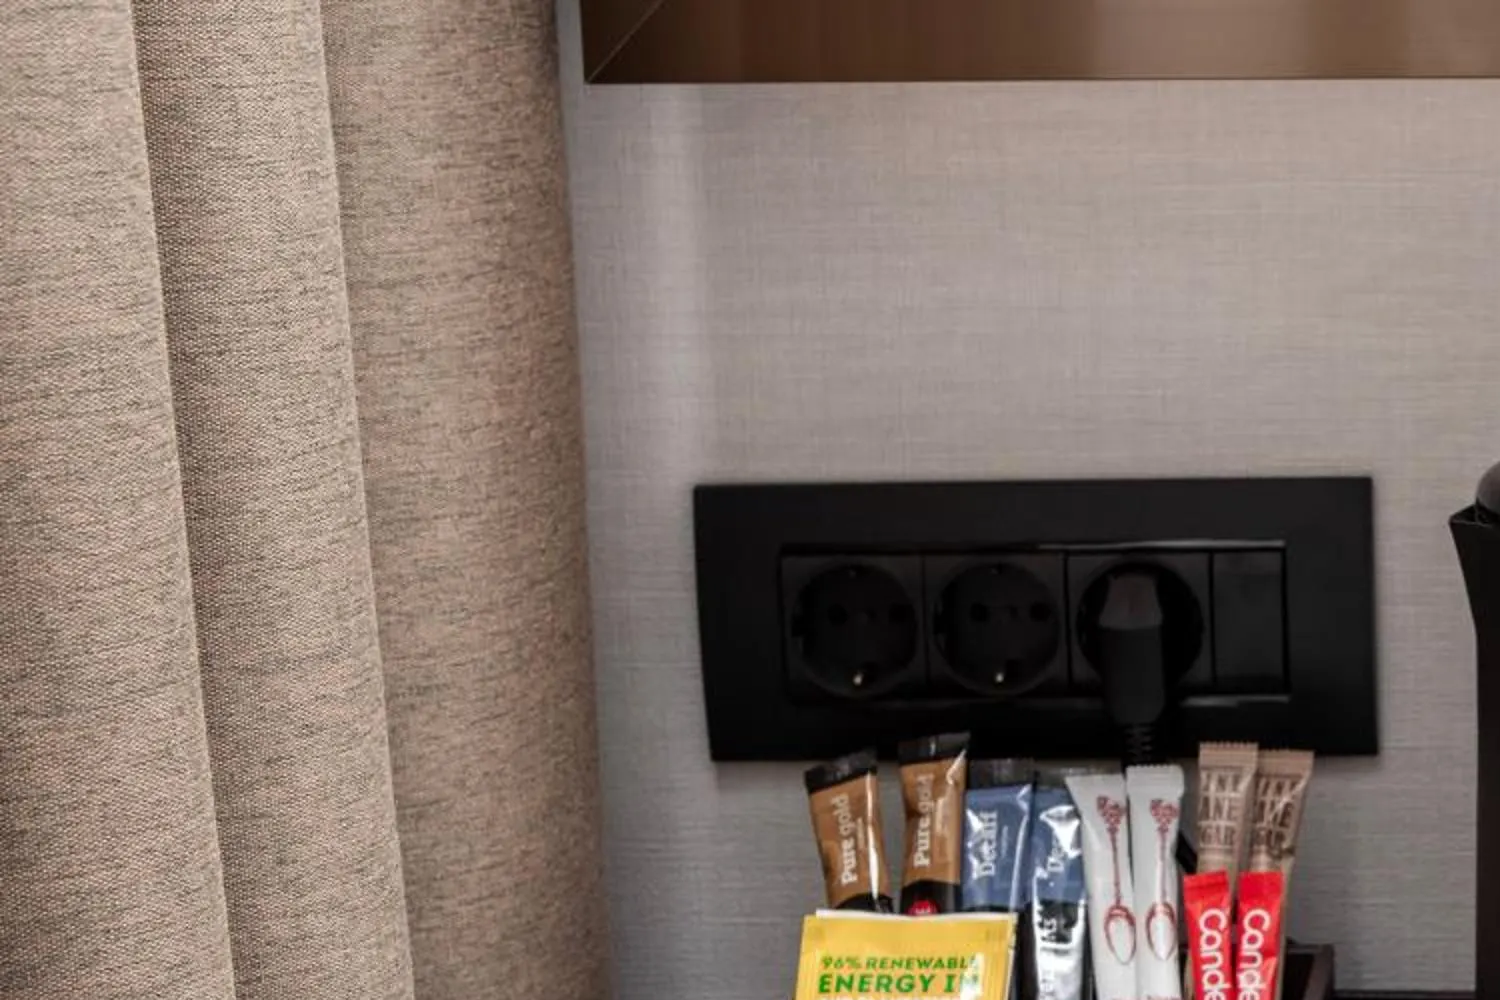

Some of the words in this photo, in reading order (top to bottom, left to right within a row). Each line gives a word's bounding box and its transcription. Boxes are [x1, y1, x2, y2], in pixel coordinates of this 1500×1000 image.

[831, 793, 856, 836] gold
[916, 774, 935, 815] gold
[840, 836, 858, 887] Pure
[914, 816, 931, 868] Pure
[817, 973, 937, 994] ENERGY
